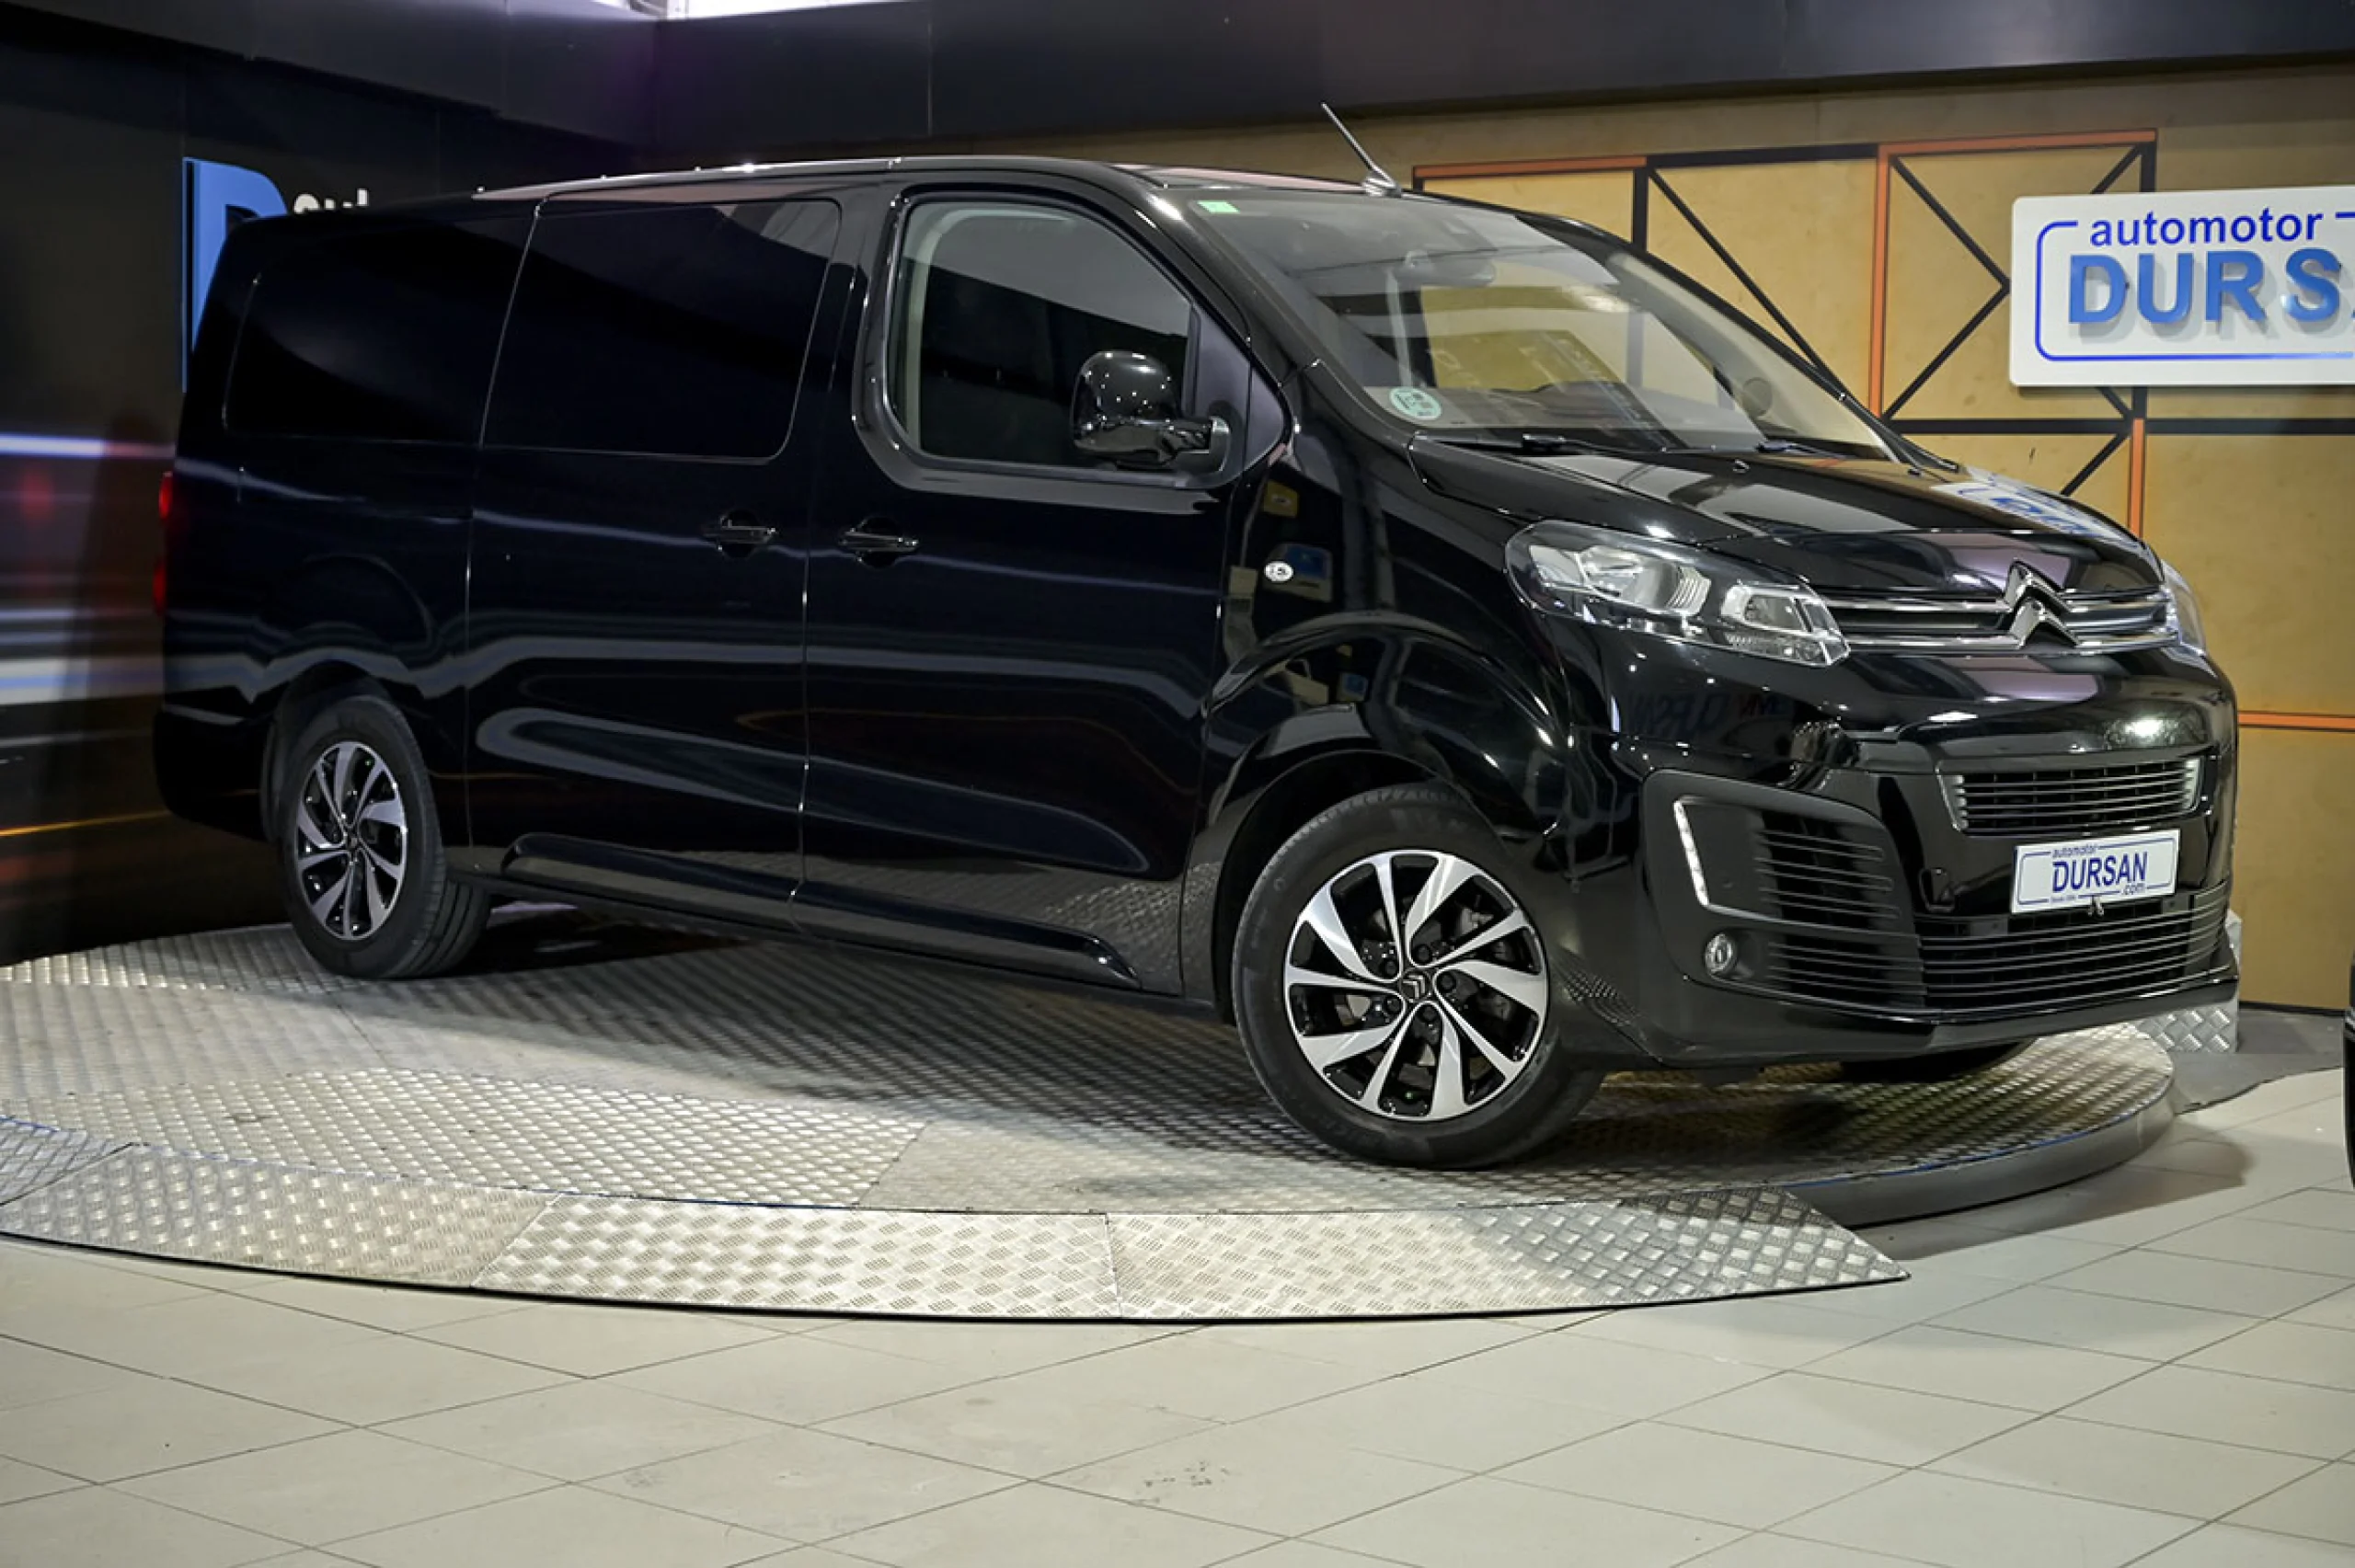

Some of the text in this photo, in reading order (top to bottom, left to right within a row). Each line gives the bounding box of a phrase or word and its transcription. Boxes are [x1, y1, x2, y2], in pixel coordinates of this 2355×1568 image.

[2090, 207, 2324, 246] automotor
[2069, 247, 2355, 324] DURS
[2052, 851, 2148, 893] DURSAN
